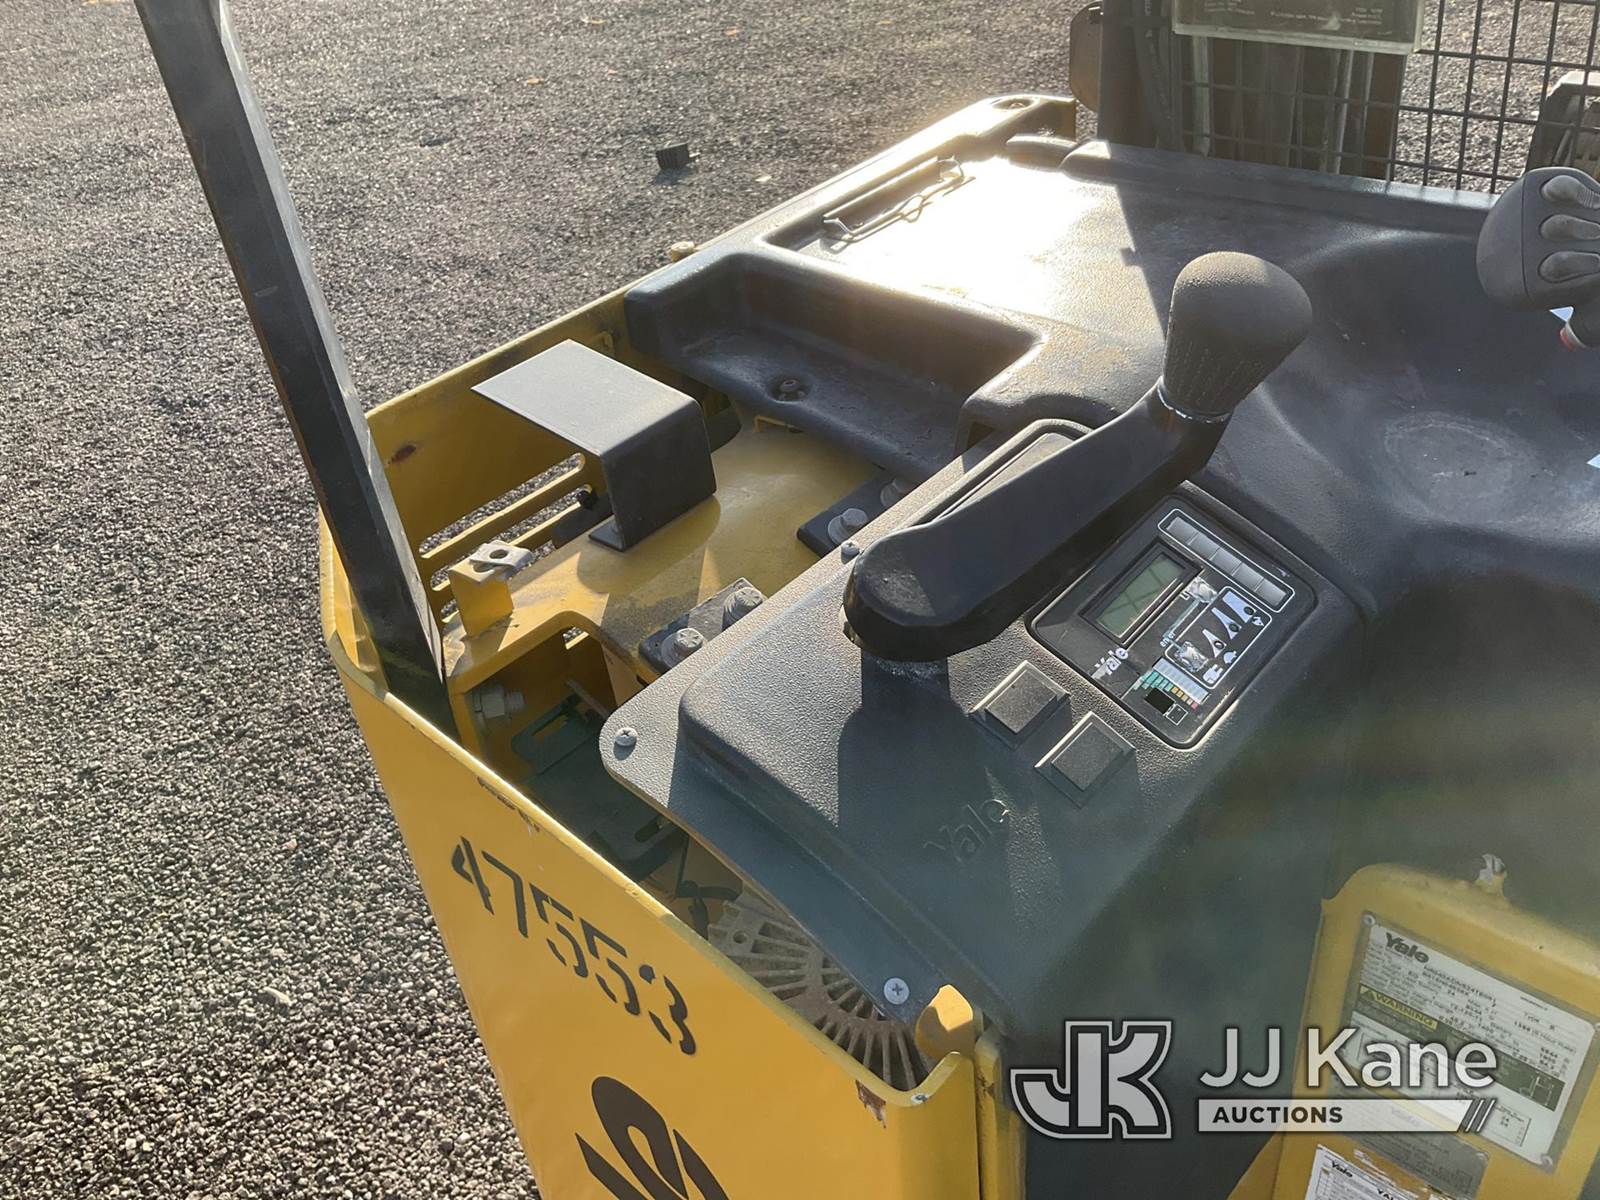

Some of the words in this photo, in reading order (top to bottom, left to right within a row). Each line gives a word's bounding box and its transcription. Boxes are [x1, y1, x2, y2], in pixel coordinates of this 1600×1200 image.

[922, 798, 1011, 863] Yale
[451, 835, 697, 1056] 47553
[1385, 931, 1430, 964] Yale
[1375, 993, 1434, 1026] WARNING
